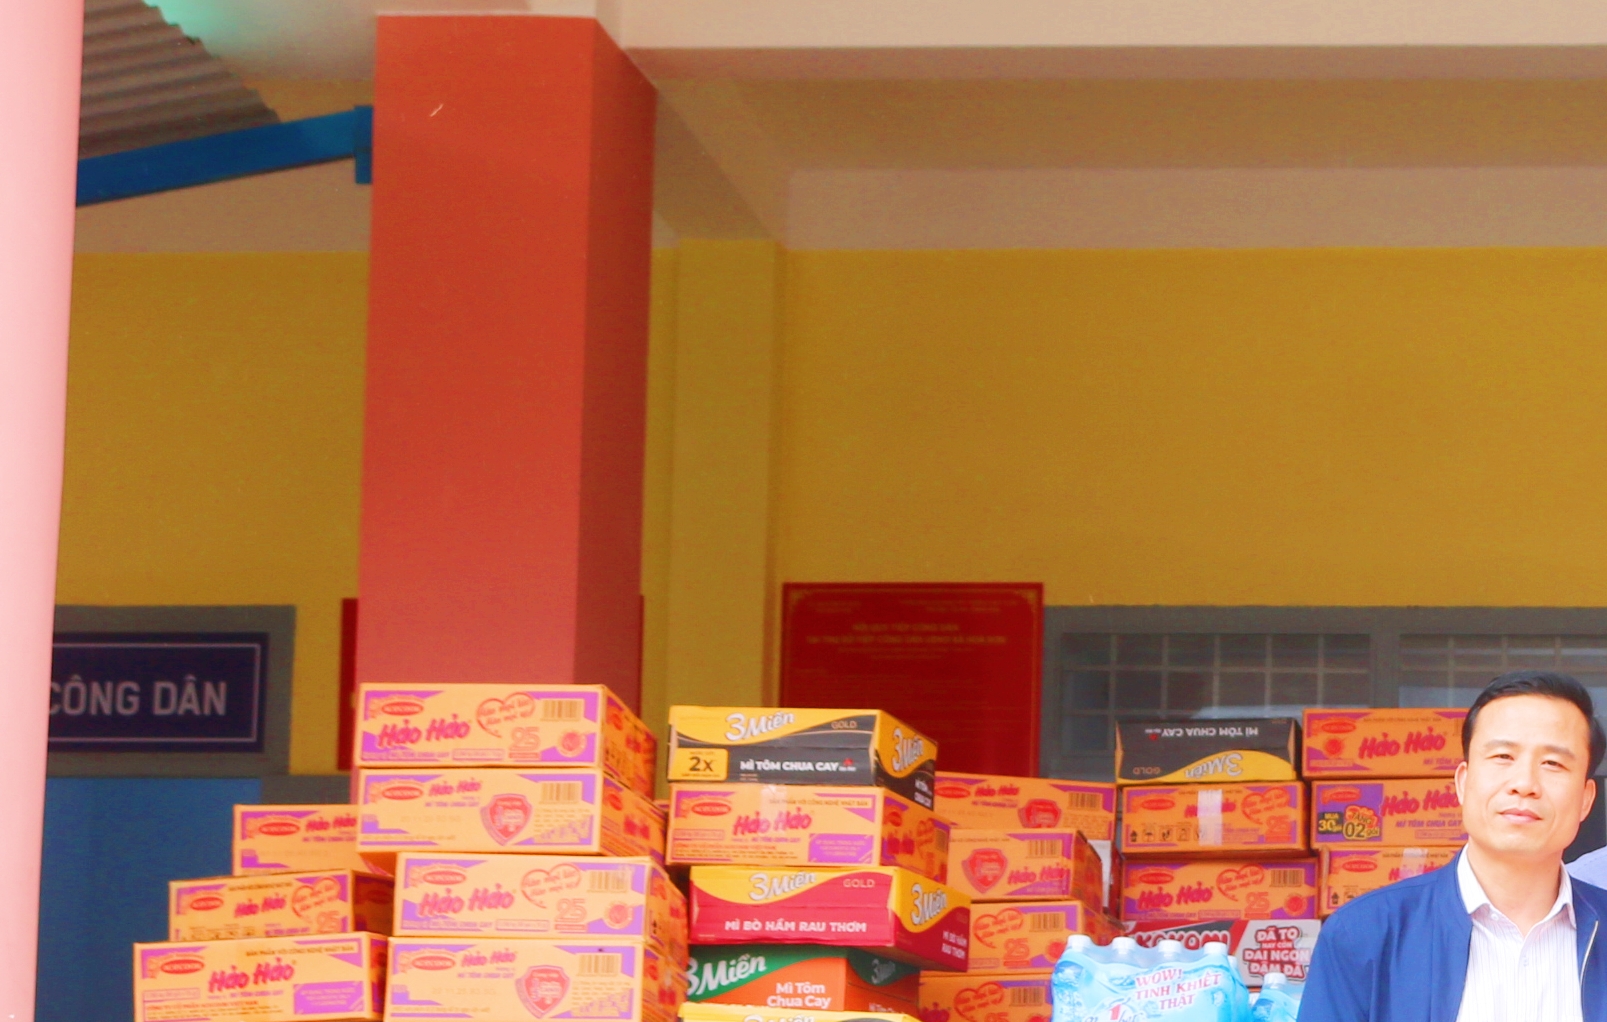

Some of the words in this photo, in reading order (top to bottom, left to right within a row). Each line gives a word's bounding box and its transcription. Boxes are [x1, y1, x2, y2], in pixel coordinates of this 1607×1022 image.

[153, 674, 226, 716] DÂN
[378, 719, 422, 748] Hảo
[426, 714, 470, 742] Hảo
[831, 720, 857, 730] GOLD
[1161, 727, 1184, 738] CAY
[1186, 727, 1215, 736] CHUA
[1218, 727, 1243, 736] TÔM
[1246, 727, 1259, 737] MÌ
[1358, 732, 1401, 759] Hảo
[1404, 726, 1446, 754] Hảo
[740, 758, 754, 771] MÌ
[756, 759, 780, 771] TÔM
[782, 761, 814, 771] CHUA
[816, 761, 839, 772] CAY
[1133, 766, 1161, 775] GOLD
[732, 811, 770, 836] Hảo
[774, 807, 812, 831] Hảo
[1344, 822, 1366, 838] 02
[843, 878, 876, 888] GOLD
[418, 889, 465, 917] Hảo
[468, 884, 515, 912] Hảo
[1138, 887, 1173, 911] Hảo
[1176, 881, 1213, 905] Hảo
[725, 919, 740, 931] MÌ
[743, 918, 761, 932] BÒ
[764, 917, 796, 932] HẦM
[799, 921, 826, 932] RAU
[830, 921, 868, 933] THƠM
[1257, 926, 1276, 941] ĐÃ
[1279, 928, 1298, 940] TO
[1245, 950, 1267, 961] DAI
[1270, 950, 1311, 962] NGON
[208, 965, 249, 993] Hảo
[253, 958, 294, 985] Hảo
[1135, 967, 1183, 988] WOW!
[1134, 984, 1171, 1001] TINH
[1158, 992, 1197, 1012] THẬT
